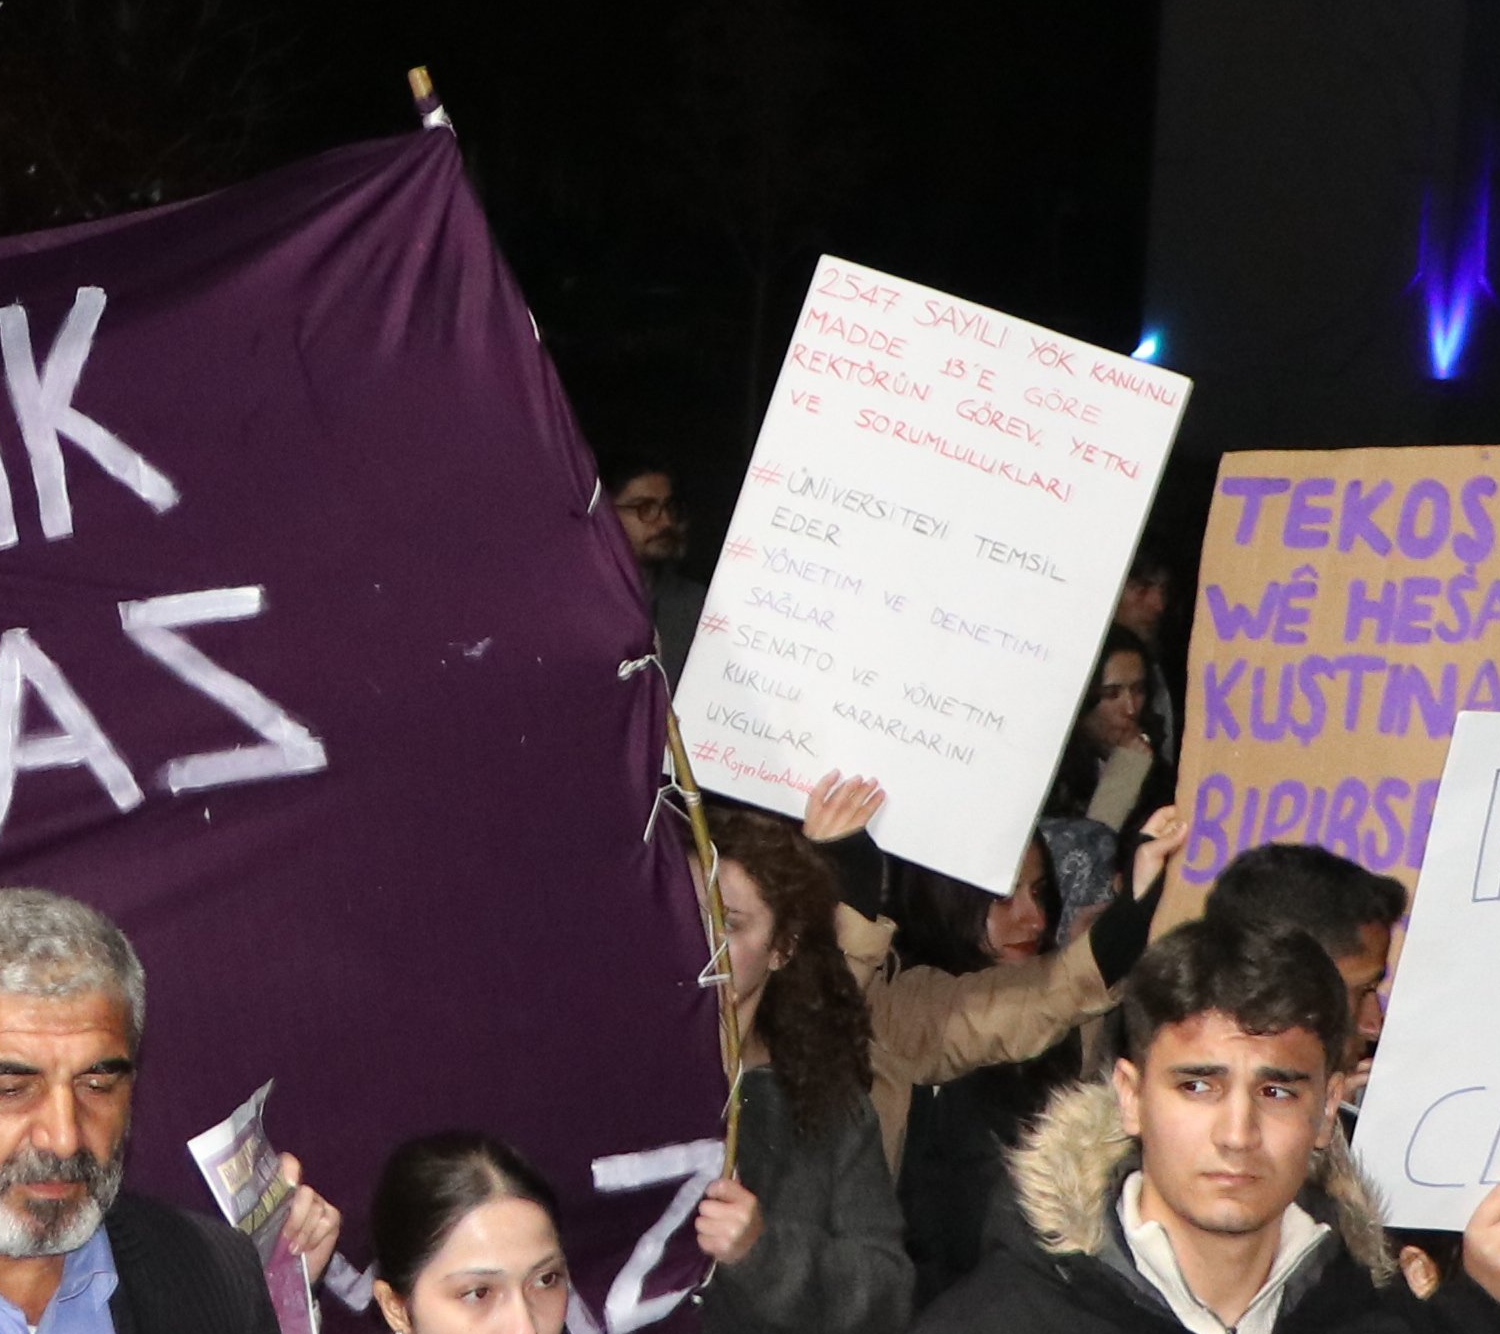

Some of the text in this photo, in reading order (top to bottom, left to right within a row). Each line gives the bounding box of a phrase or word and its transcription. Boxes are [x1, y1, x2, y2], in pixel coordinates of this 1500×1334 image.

[802, 306, 907, 361] MADDE
[1022, 384, 1103, 427] GÖRE
[815, 267, 901, 317] 2547
[913, 299, 1010, 349] SAYILI
[1089, 360, 1180, 409] KANUNU
[789, 343, 932, 404] REKTÖRÜN
[1070, 434, 1140, 480] YETKİ
[789, 389, 1074, 504] VE SORUMLULUKLARI
[770, 507, 842, 548] EDER
[974, 533, 1067, 583] TEMSİL
[744, 584, 836, 635] SAĞLAR
[882, 589, 907, 615] VE
[1205, 564, 1320, 645] WÊ
[721, 659, 976, 765] KURULU KARARLARINI
[851, 665, 878, 691] VE
[706, 703, 819, 759] UYGULAR
